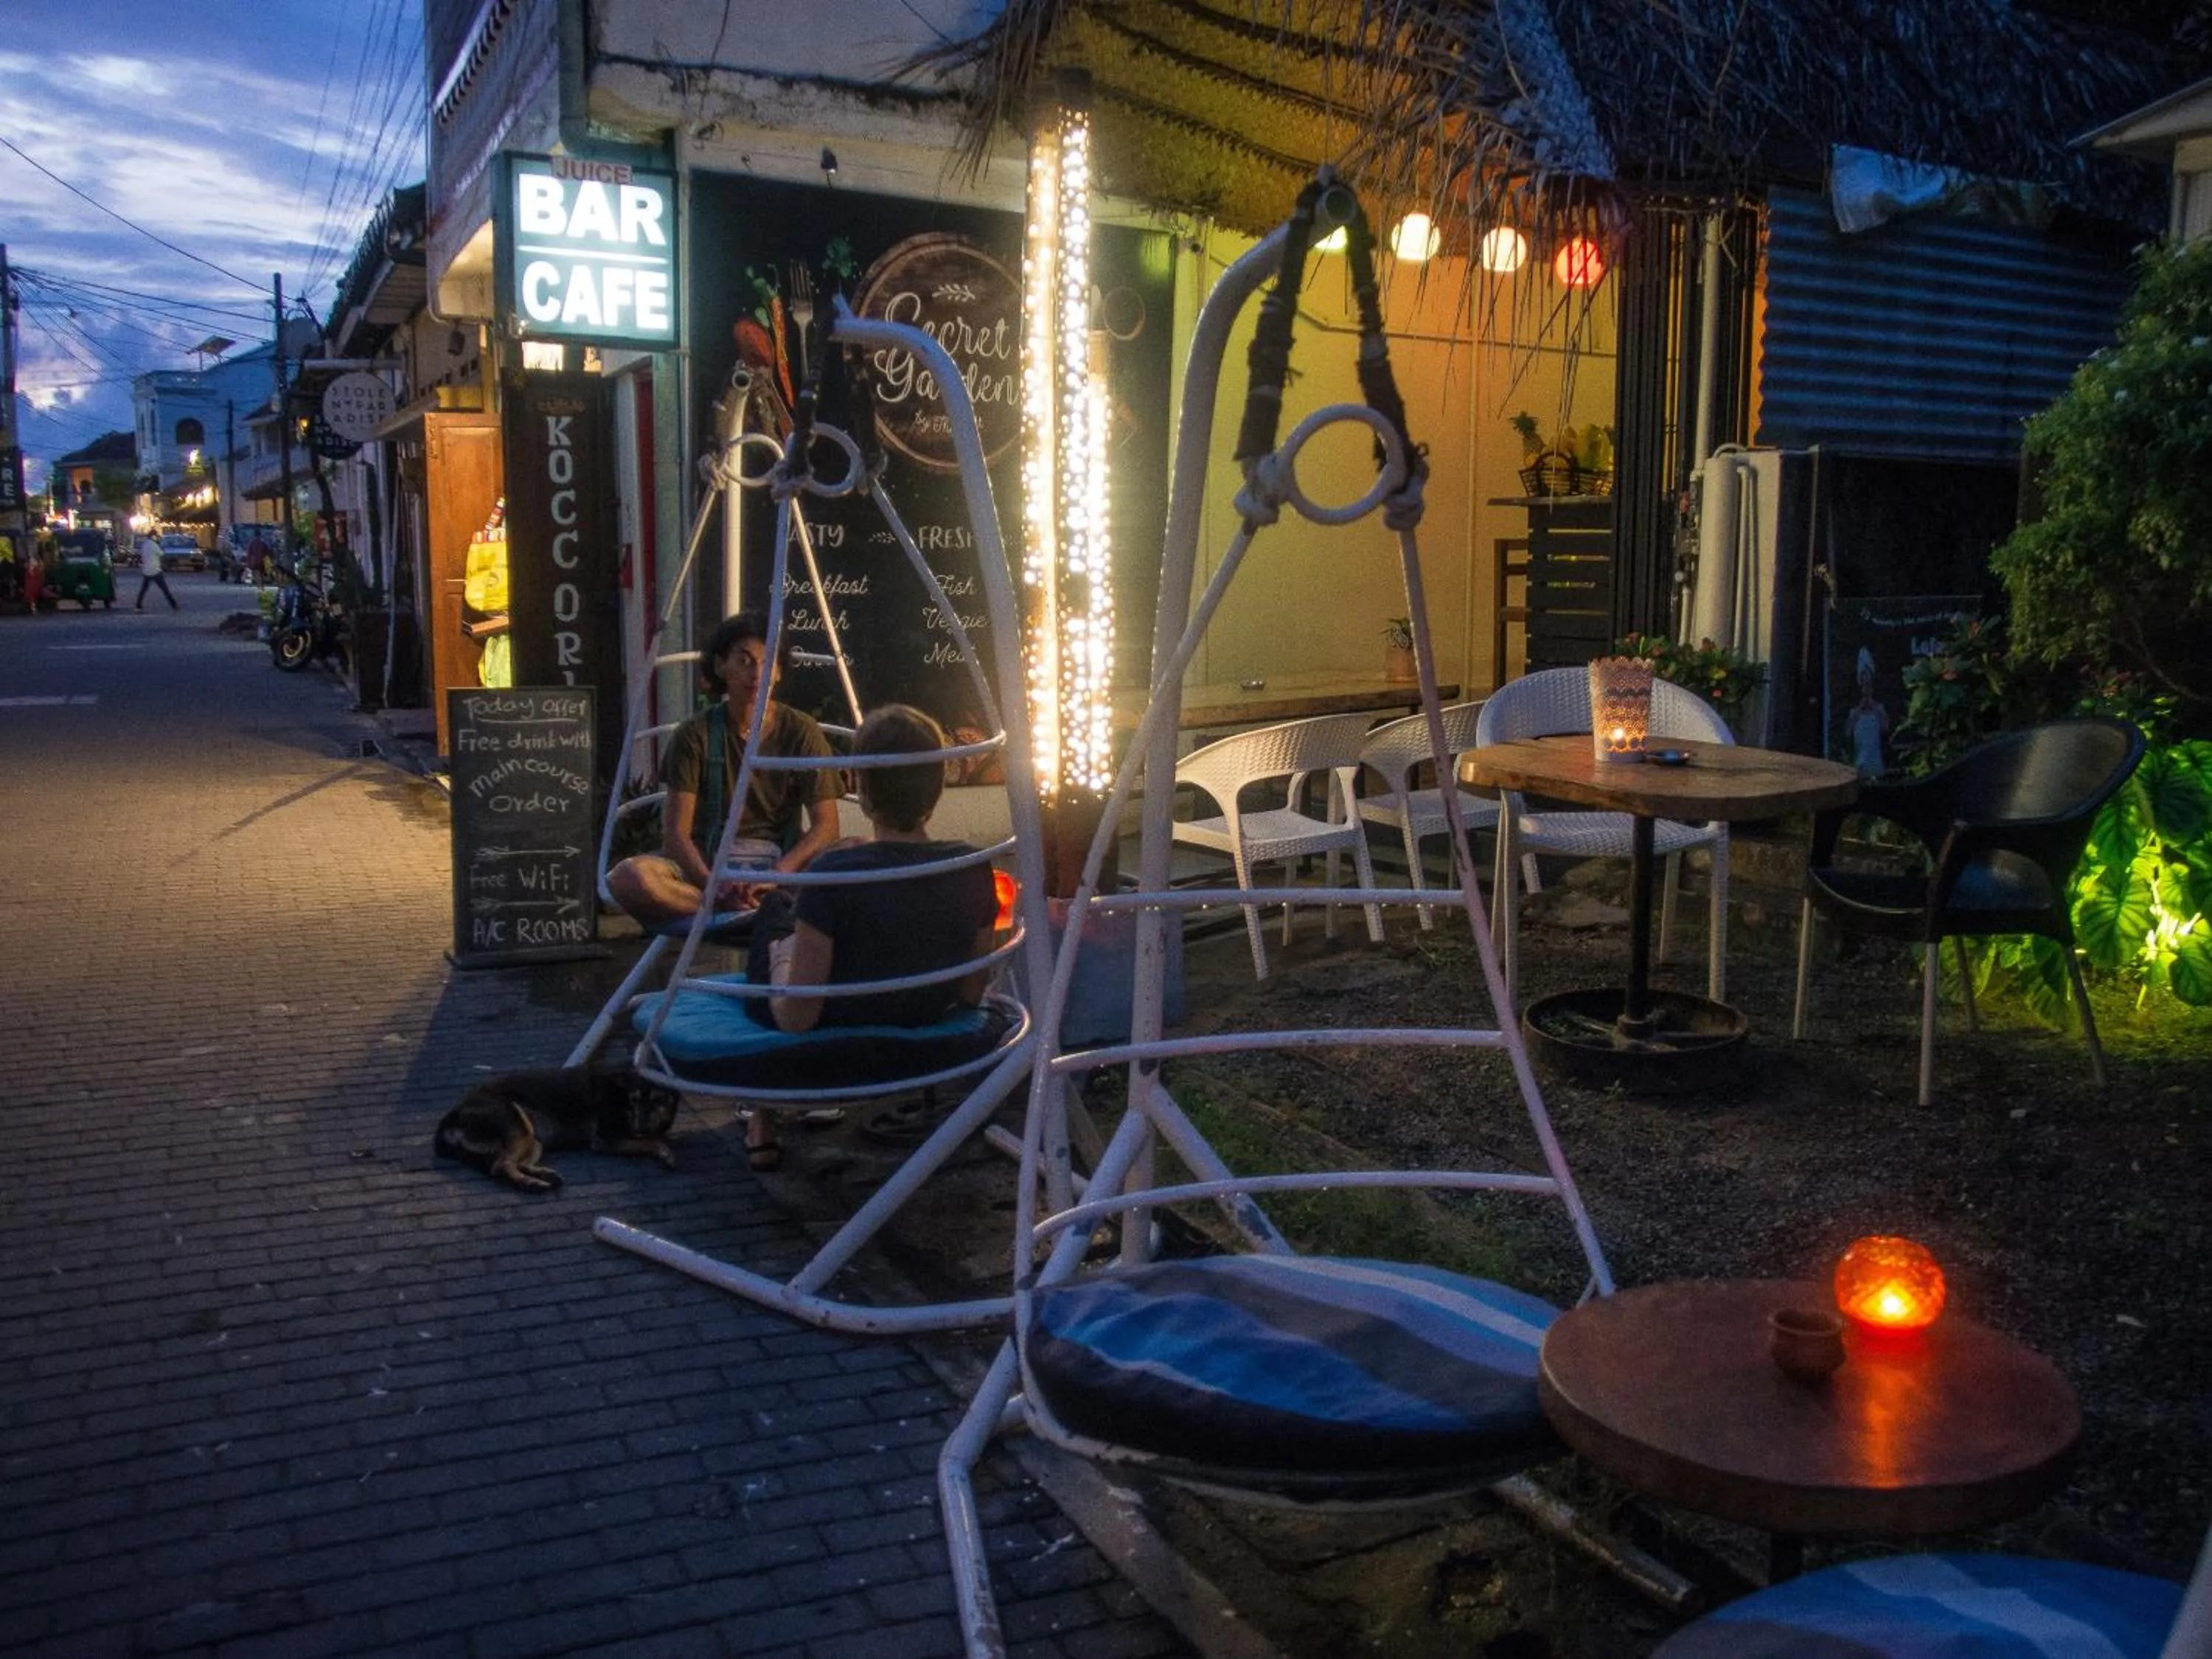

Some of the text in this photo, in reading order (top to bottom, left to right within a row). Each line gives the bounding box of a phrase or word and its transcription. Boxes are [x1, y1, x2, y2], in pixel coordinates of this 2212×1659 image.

[556, 159, 632, 184] JUICE
[518, 173, 667, 246] BAR
[522, 261, 668, 330] CAFE
[874, 348, 1021, 406] Gaden
[787, 522, 844, 548] ASTY
[769, 572, 872, 599] Brekfast
[924, 641, 976, 669] Mea
[463, 697, 535, 720] Today
[458, 728, 502, 751] Free
[489, 790, 571, 813] Order
[470, 863, 508, 891] Free
[473, 917, 507, 947] A/C
